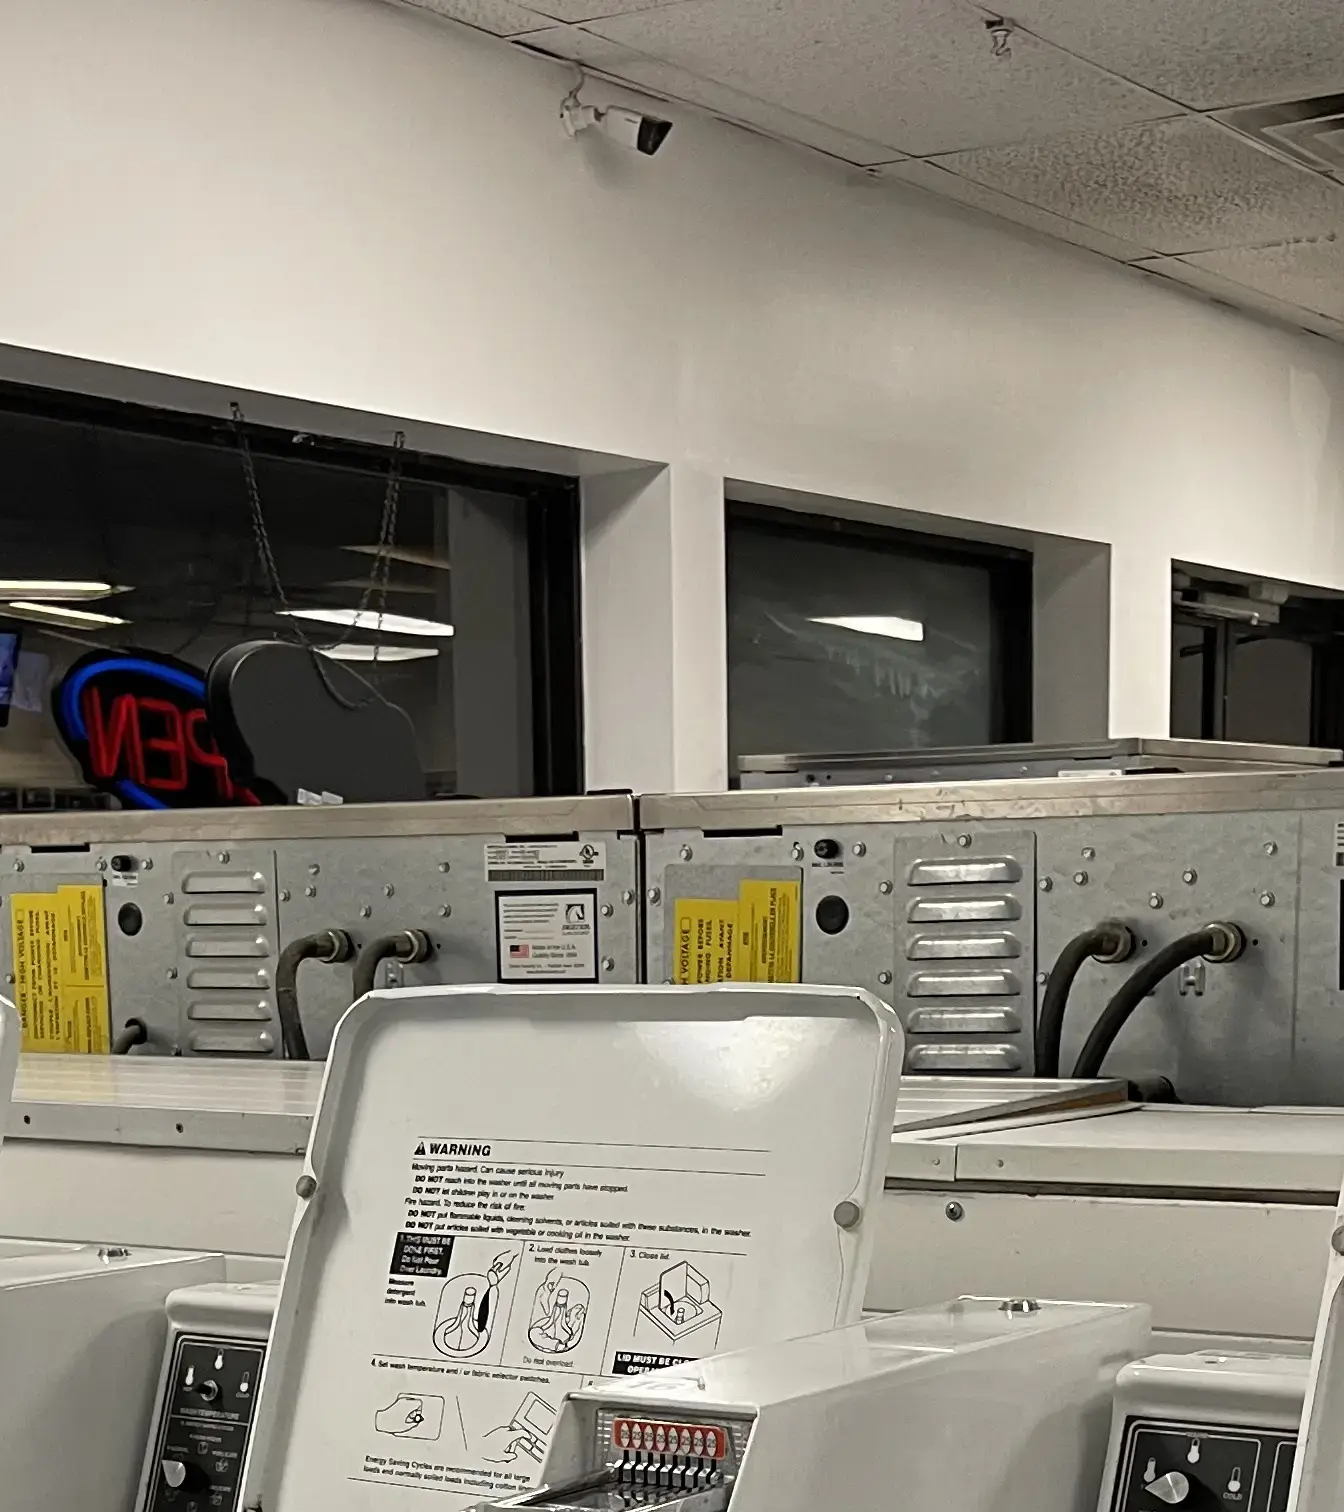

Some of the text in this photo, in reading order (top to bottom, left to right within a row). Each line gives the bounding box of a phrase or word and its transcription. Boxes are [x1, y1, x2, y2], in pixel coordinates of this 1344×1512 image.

[681, 929, 690, 973] VOLTAGE
[429, 1143, 491, 1156] WARNING
[638, 1252, 658, 1260] Close
[617, 1354, 670, 1366] LID MUST BE
